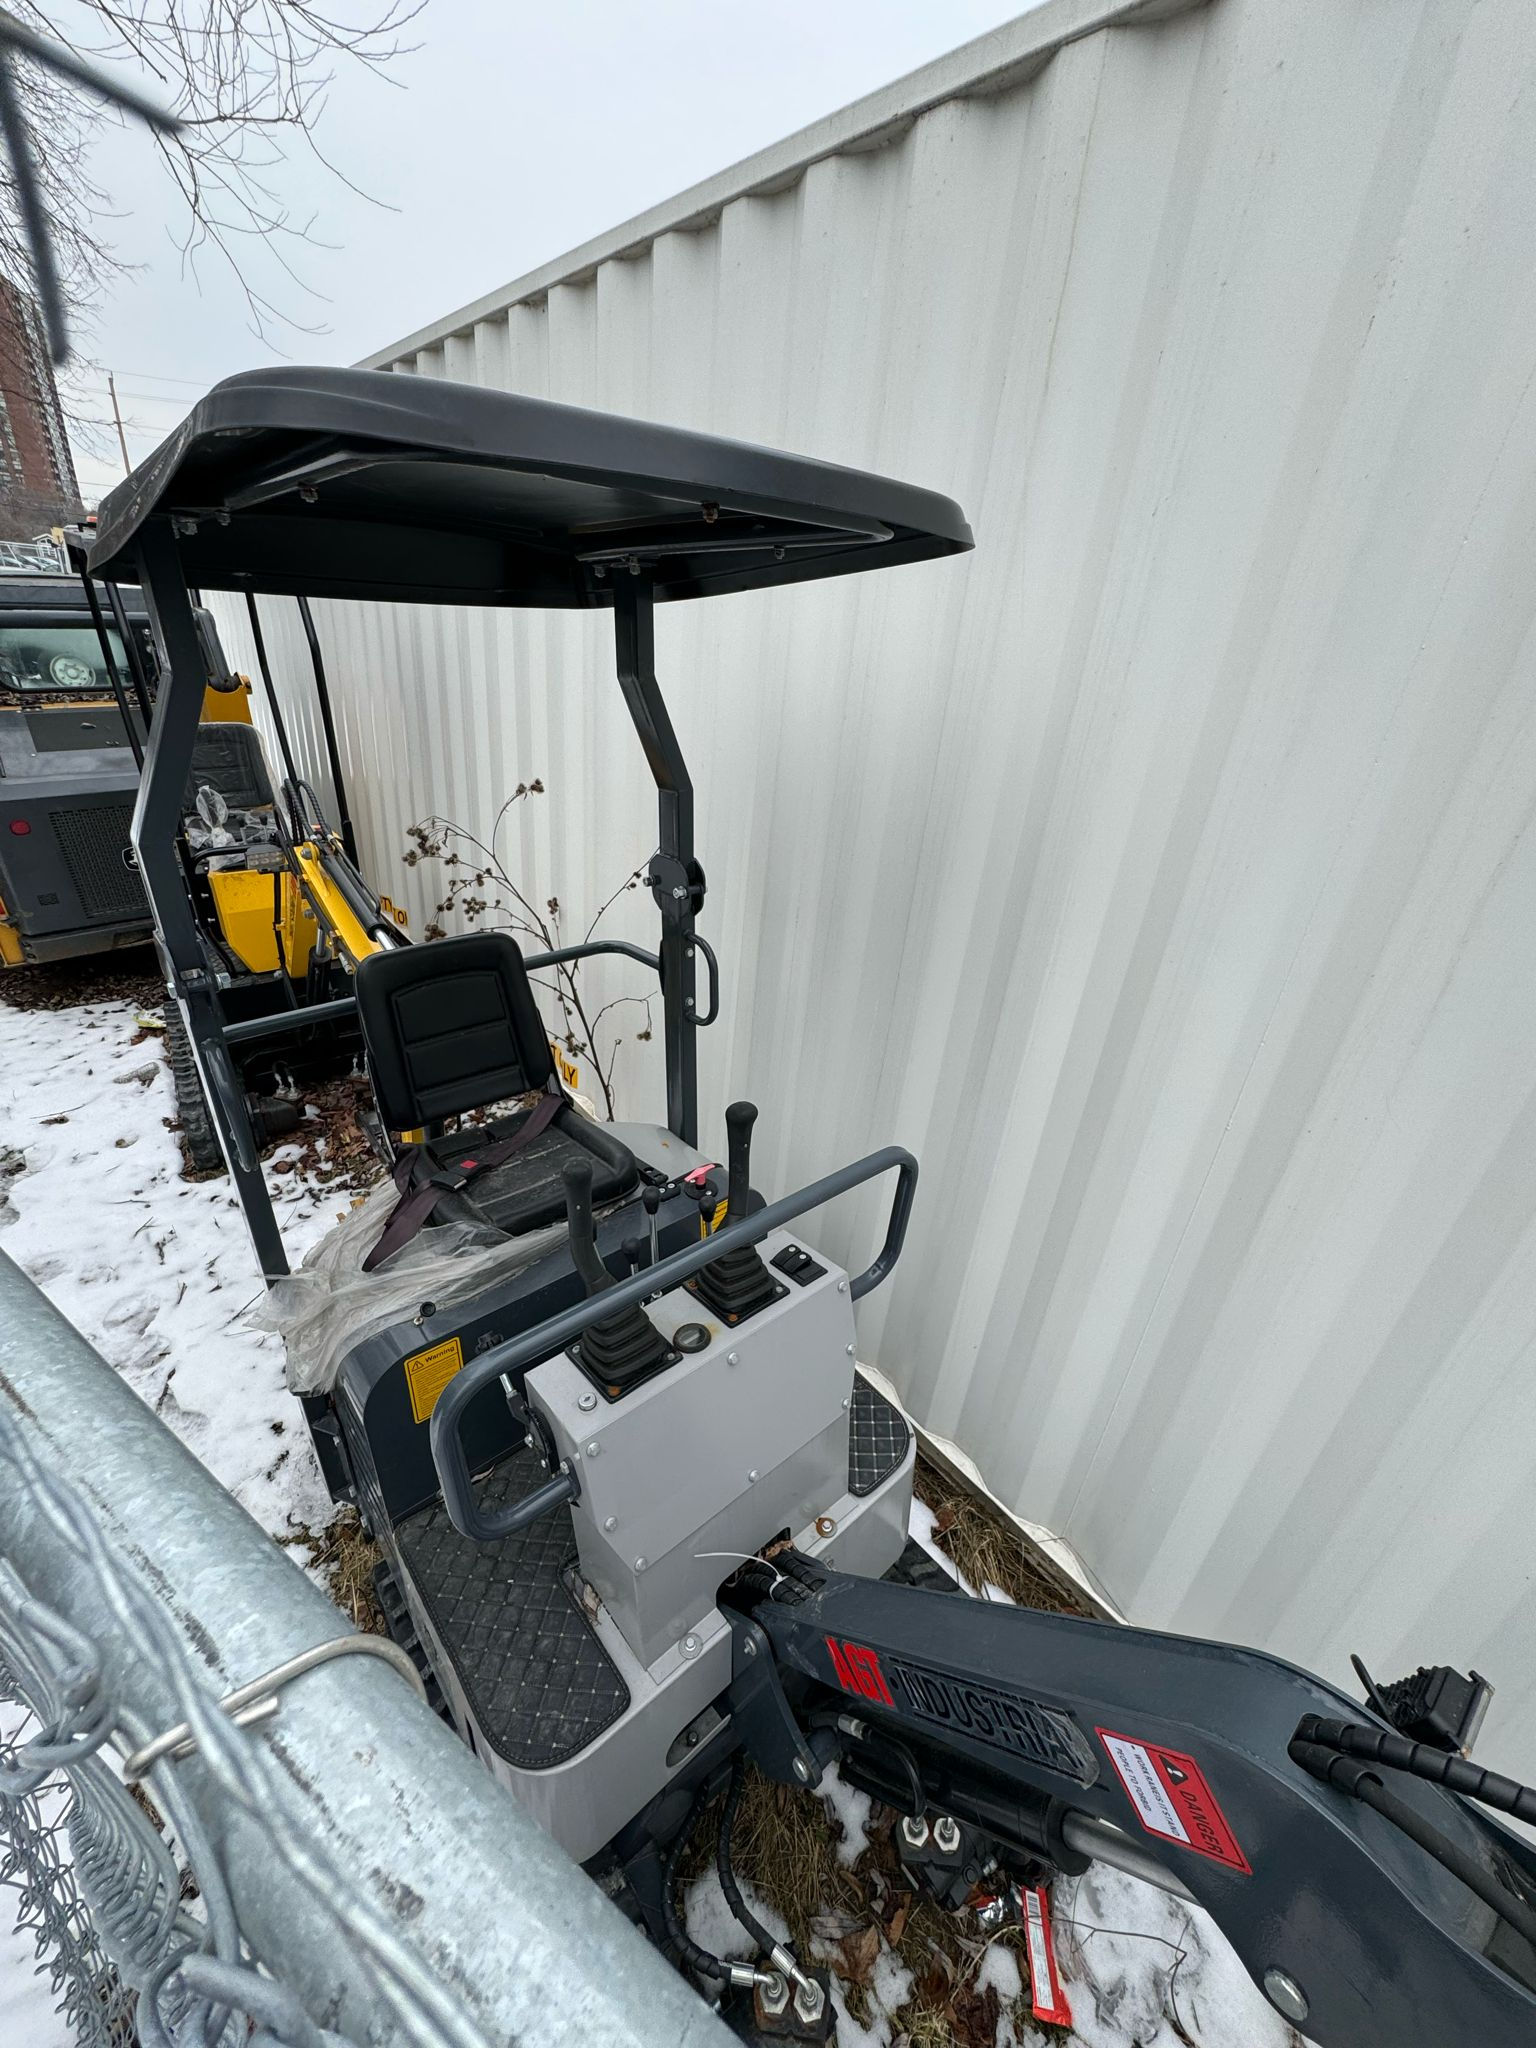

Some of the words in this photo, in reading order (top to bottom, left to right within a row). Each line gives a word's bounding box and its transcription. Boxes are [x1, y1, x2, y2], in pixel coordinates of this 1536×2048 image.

[425, 1346, 455, 1362] Warning
[825, 1635, 894, 1707] AGT
[1115, 1747, 1133, 1773] PEOPLE
[1180, 1789, 1224, 1854] DANGER
